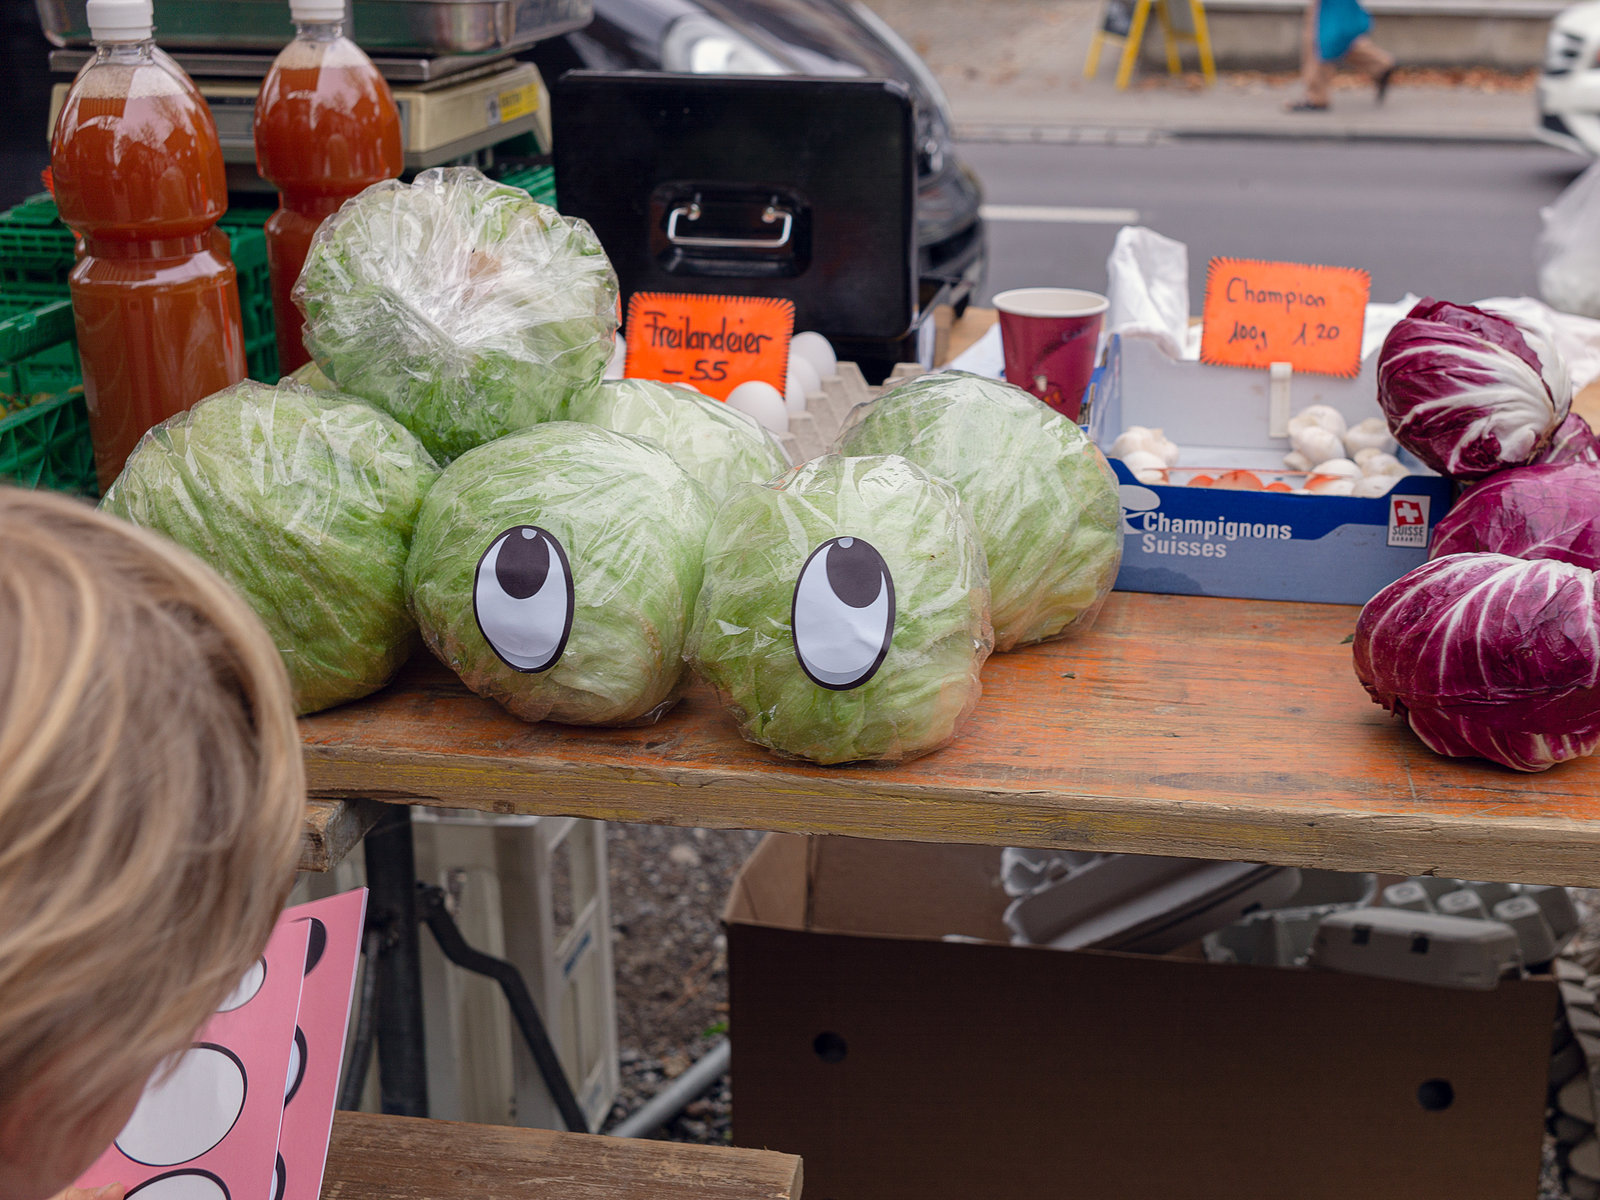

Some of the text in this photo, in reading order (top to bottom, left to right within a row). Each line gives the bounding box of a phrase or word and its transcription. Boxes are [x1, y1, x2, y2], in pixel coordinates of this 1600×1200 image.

[1227, 277, 1326, 313] Champion
[643, 310, 773, 354] Freilandeier
[1228, 321, 1268, 351] 100g
[1142, 511, 1293, 542] Champignons
[1392, 525, 1424, 537] SUISSE
[1141, 533, 1228, 559] Suisses
